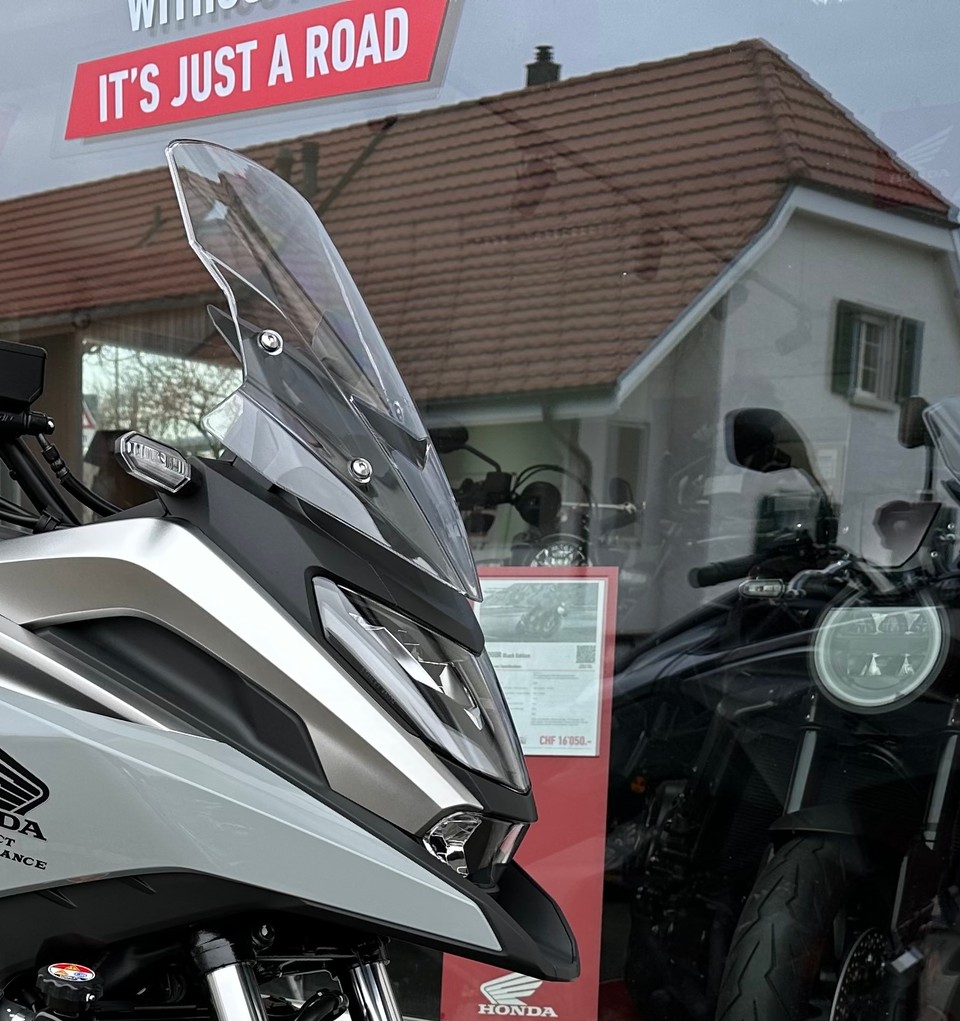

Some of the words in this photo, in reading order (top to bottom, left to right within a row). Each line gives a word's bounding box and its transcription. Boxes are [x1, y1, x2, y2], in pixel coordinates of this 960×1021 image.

[99, 63, 160, 123] IT'S
[170, 40, 258, 107] JUST
[267, 33, 294, 87] A
[305, 7, 410, 79] ROAD
[539, 735, 557, 746] CHF
[478, 1003, 559, 1019] HONDA
